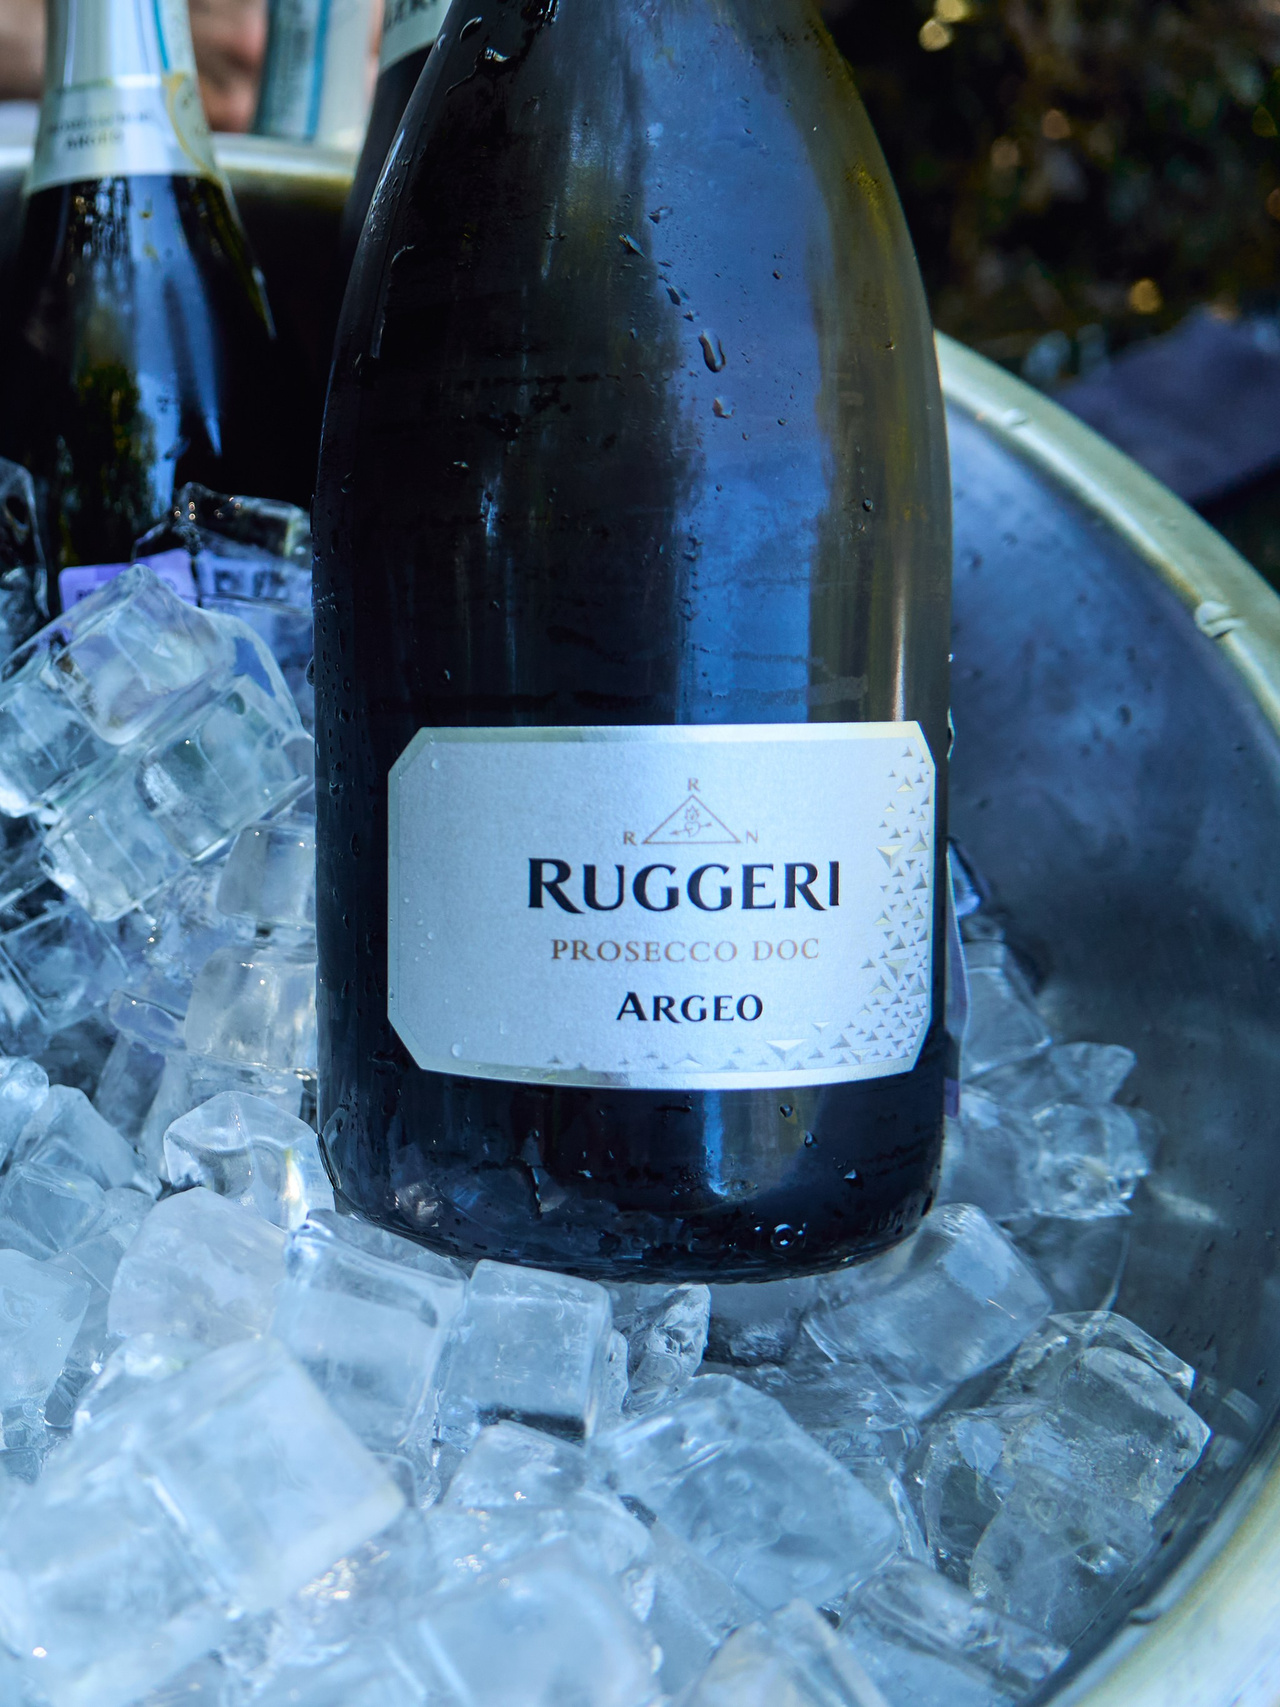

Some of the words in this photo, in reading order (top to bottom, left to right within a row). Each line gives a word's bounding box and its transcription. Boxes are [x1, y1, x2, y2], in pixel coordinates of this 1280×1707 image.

[687, 777, 701, 792] R
[623, 831, 637, 846] R
[745, 829, 759, 844] N
[528, 857, 840, 914] RUGGERI
[551, 938, 739, 963] PROSECCO
[751, 938, 820, 961] DOC
[616, 991, 764, 1024] ARGEO
